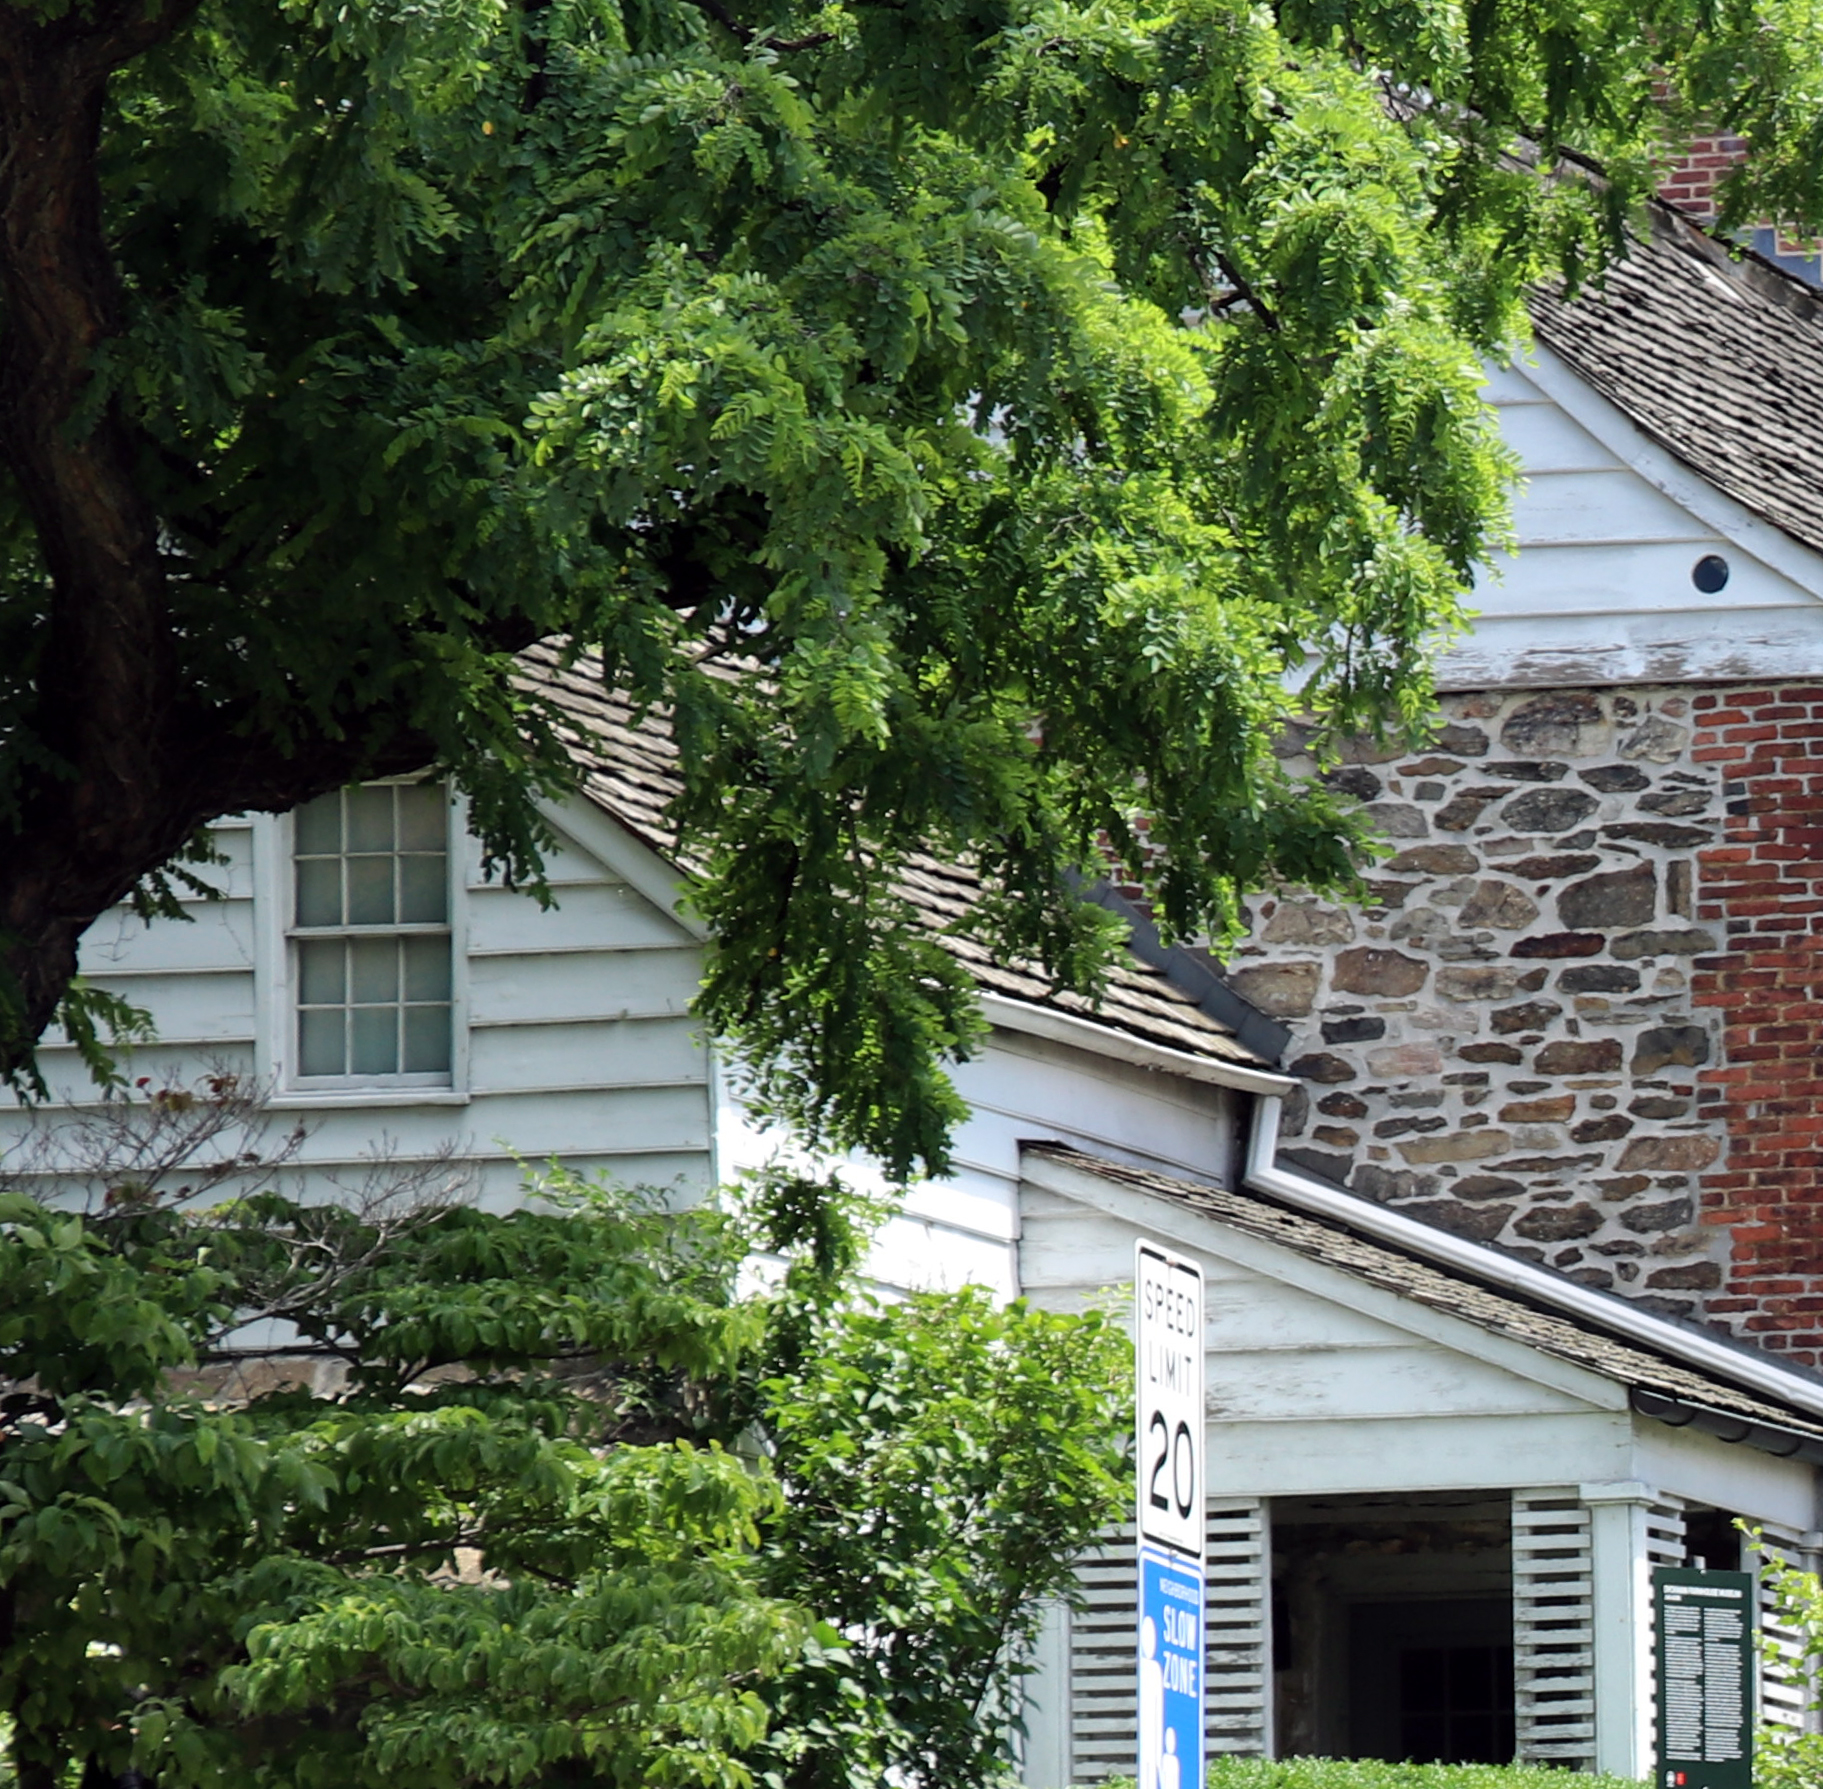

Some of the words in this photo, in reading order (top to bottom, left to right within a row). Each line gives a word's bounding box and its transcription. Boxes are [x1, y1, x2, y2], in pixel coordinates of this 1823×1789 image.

[1145, 1279, 1195, 1338] SPEED
[1149, 1340, 1192, 1397] LIMIT
[1149, 1409, 1194, 1520] 20
[1163, 1604, 1197, 1652] SLOW
[1162, 1651, 1197, 1698] ZONE
